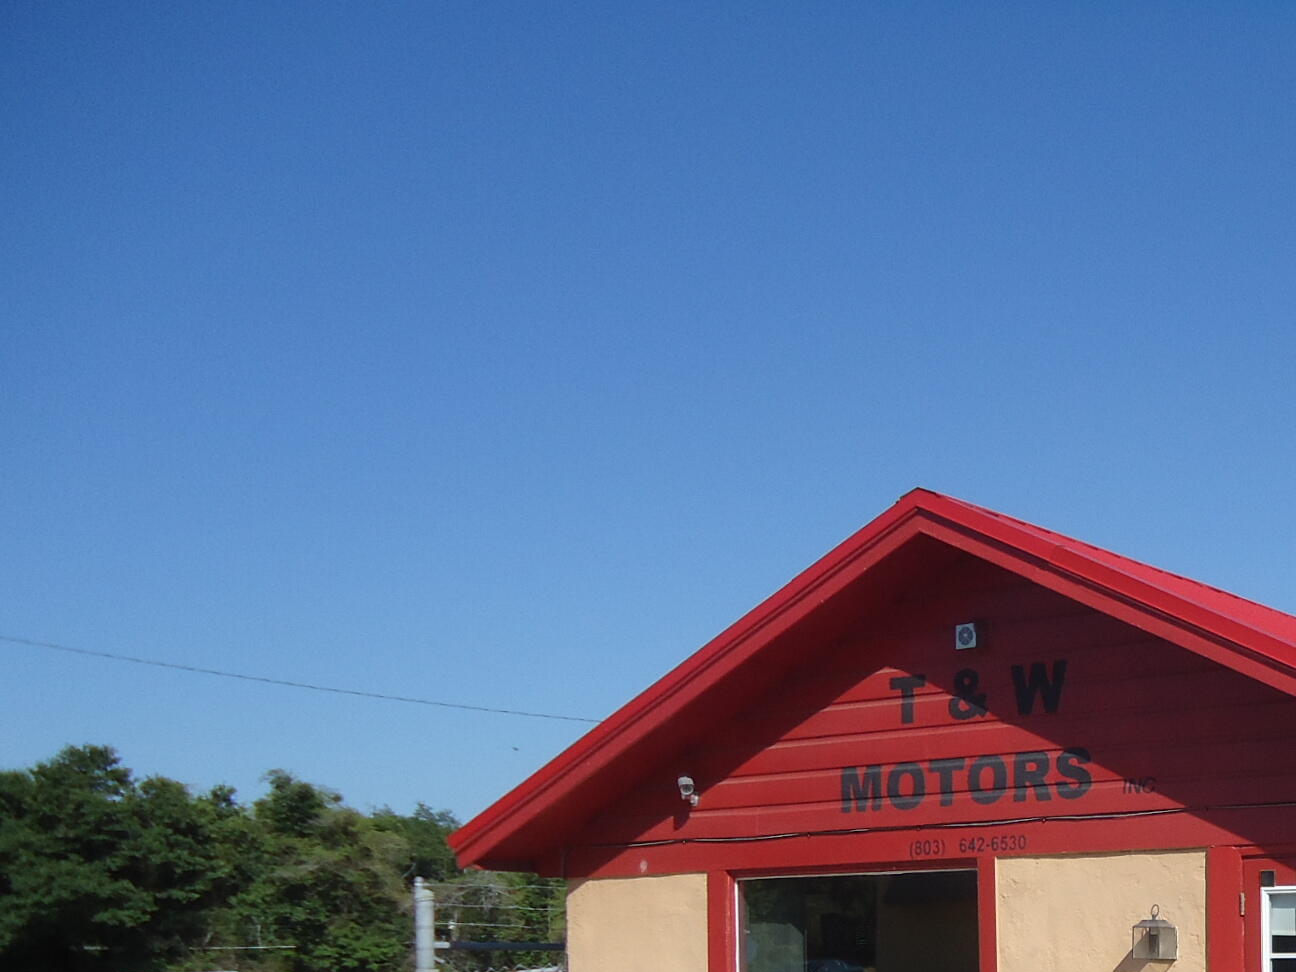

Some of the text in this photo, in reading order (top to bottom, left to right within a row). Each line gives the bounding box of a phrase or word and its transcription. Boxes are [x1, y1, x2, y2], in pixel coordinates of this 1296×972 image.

[889, 659, 1068, 724] T & W
[840, 747, 1093, 814] MOTORS
[1122, 776, 1157, 795] INC
[909, 835, 1027, 859] (803) 642-6530
